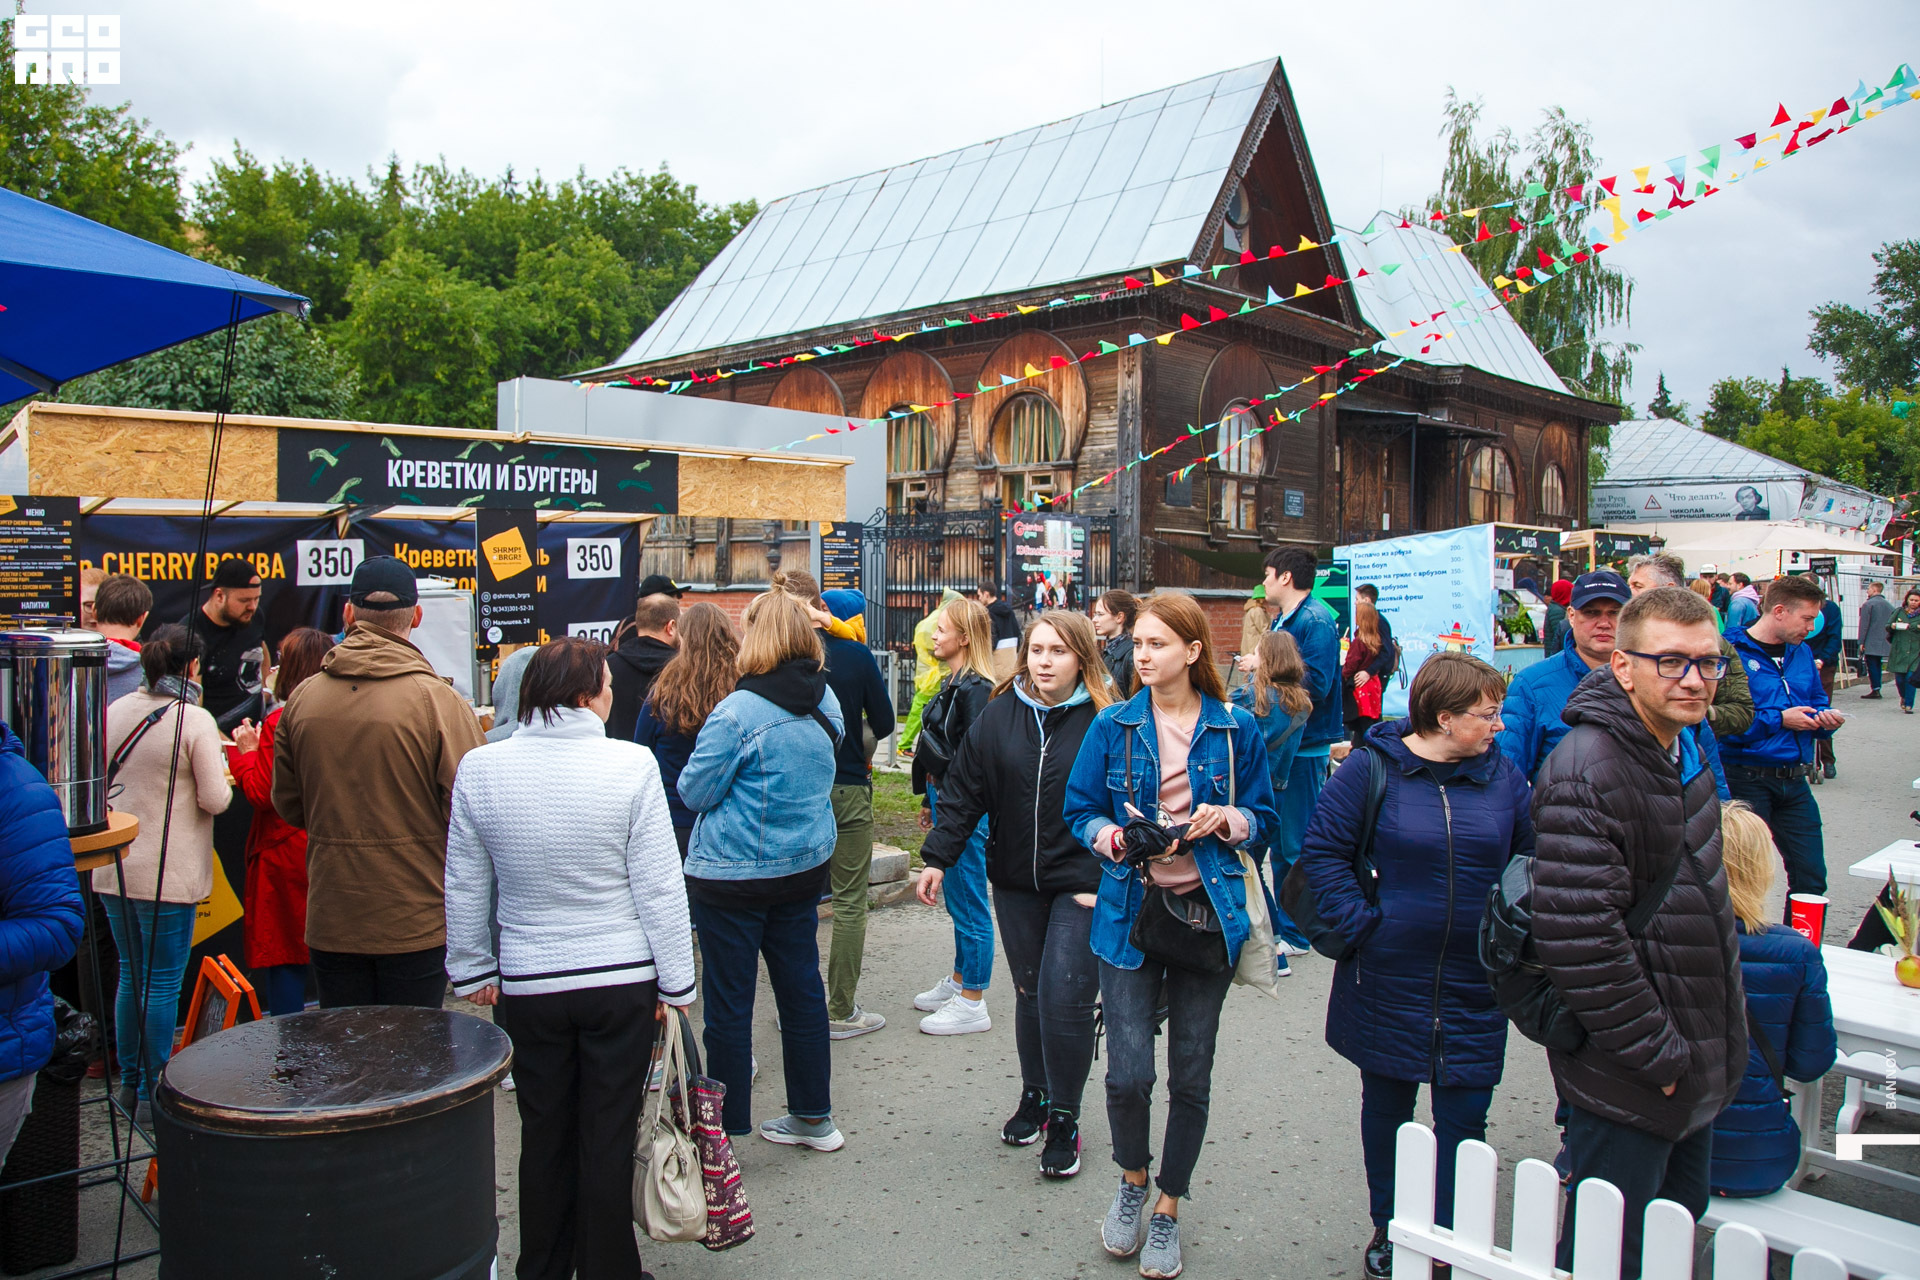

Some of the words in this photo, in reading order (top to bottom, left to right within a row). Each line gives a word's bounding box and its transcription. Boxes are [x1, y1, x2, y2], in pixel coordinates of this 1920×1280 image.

[387, 459, 491, 490] КРЕВЕТКИ
[496, 464, 509, 490] И
[514, 465, 598, 495] БУРГЕРЫ
[25, 508, 46, 517] МЕНЮ
[102, 552, 197, 580] CHERRY
[308, 547, 353, 577] 350
[577, 544, 612, 572] 350
[21, 601, 50, 609] НАПИТКИ
